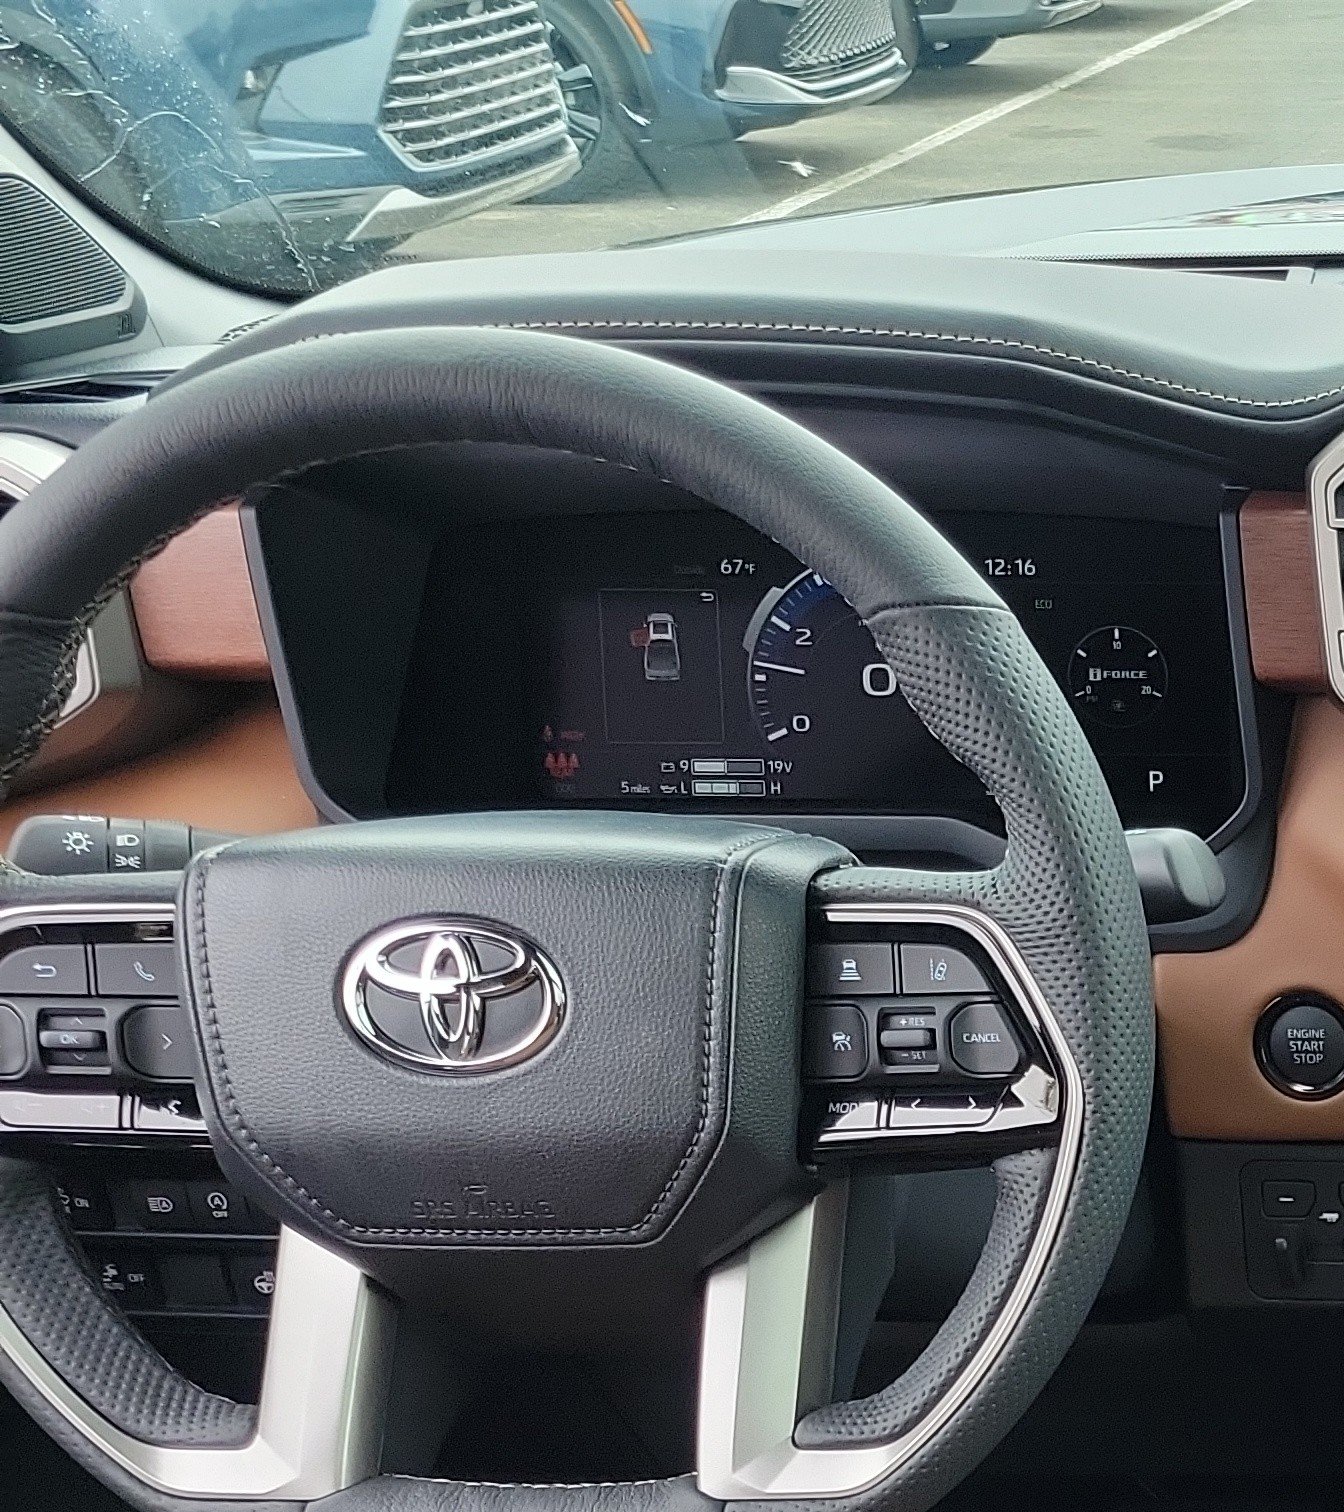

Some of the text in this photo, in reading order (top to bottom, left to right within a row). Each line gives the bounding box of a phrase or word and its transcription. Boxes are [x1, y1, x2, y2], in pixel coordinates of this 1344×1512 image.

[985, 558, 1036, 576] 12:16
[795, 628, 813, 645] 2
[792, 715, 810, 732] 0
[680, 761, 689, 772] 9
[767, 761, 792, 773] 19V
[1149, 770, 1163, 792] P
[963, 1033, 1001, 1043] CANCEL
[1287, 1028, 1326, 1039] ENGINE
[1289, 1040, 1324, 1052] START
[1293, 1053, 1324, 1064] STOP
